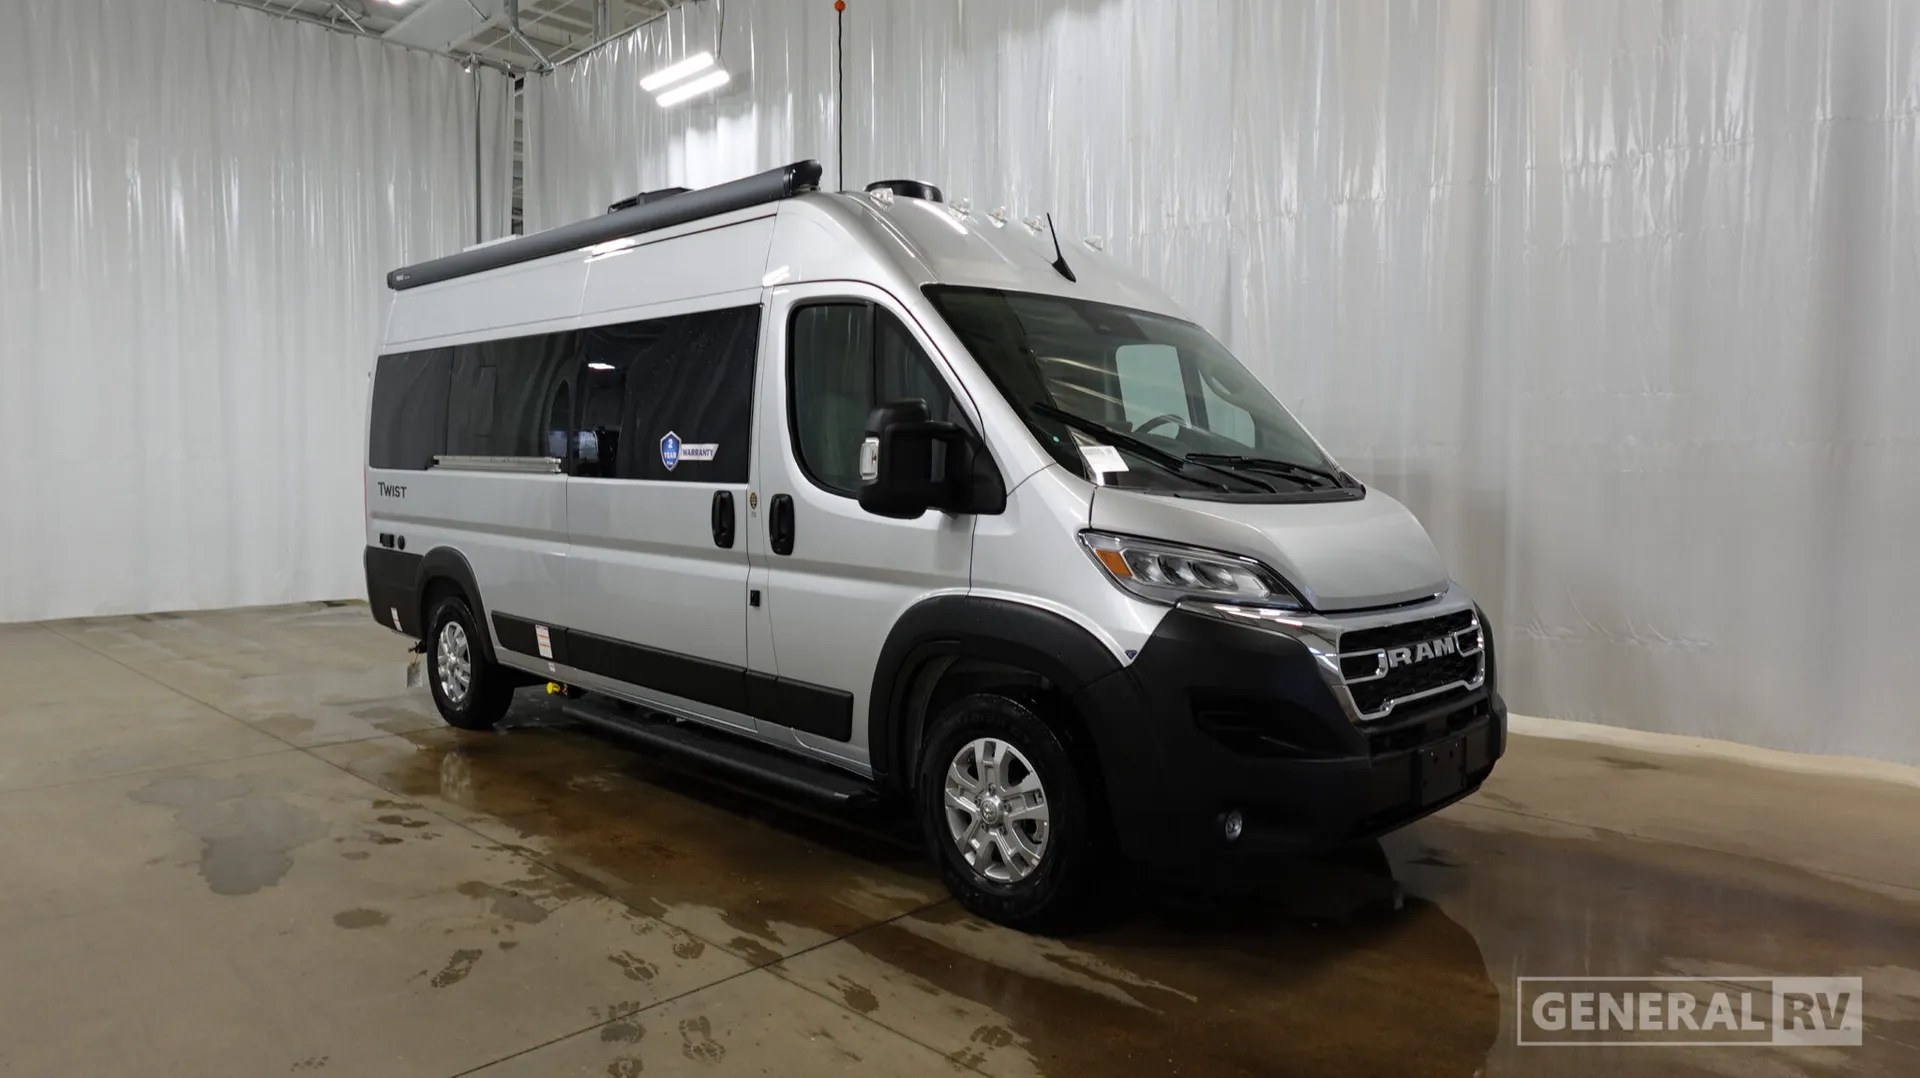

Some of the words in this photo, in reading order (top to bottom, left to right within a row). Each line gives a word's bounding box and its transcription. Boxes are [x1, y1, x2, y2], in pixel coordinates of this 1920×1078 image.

[668, 438, 673, 449] 2
[682, 448, 713, 457] WARRANTY
[1387, 637, 1455, 668] RAM
